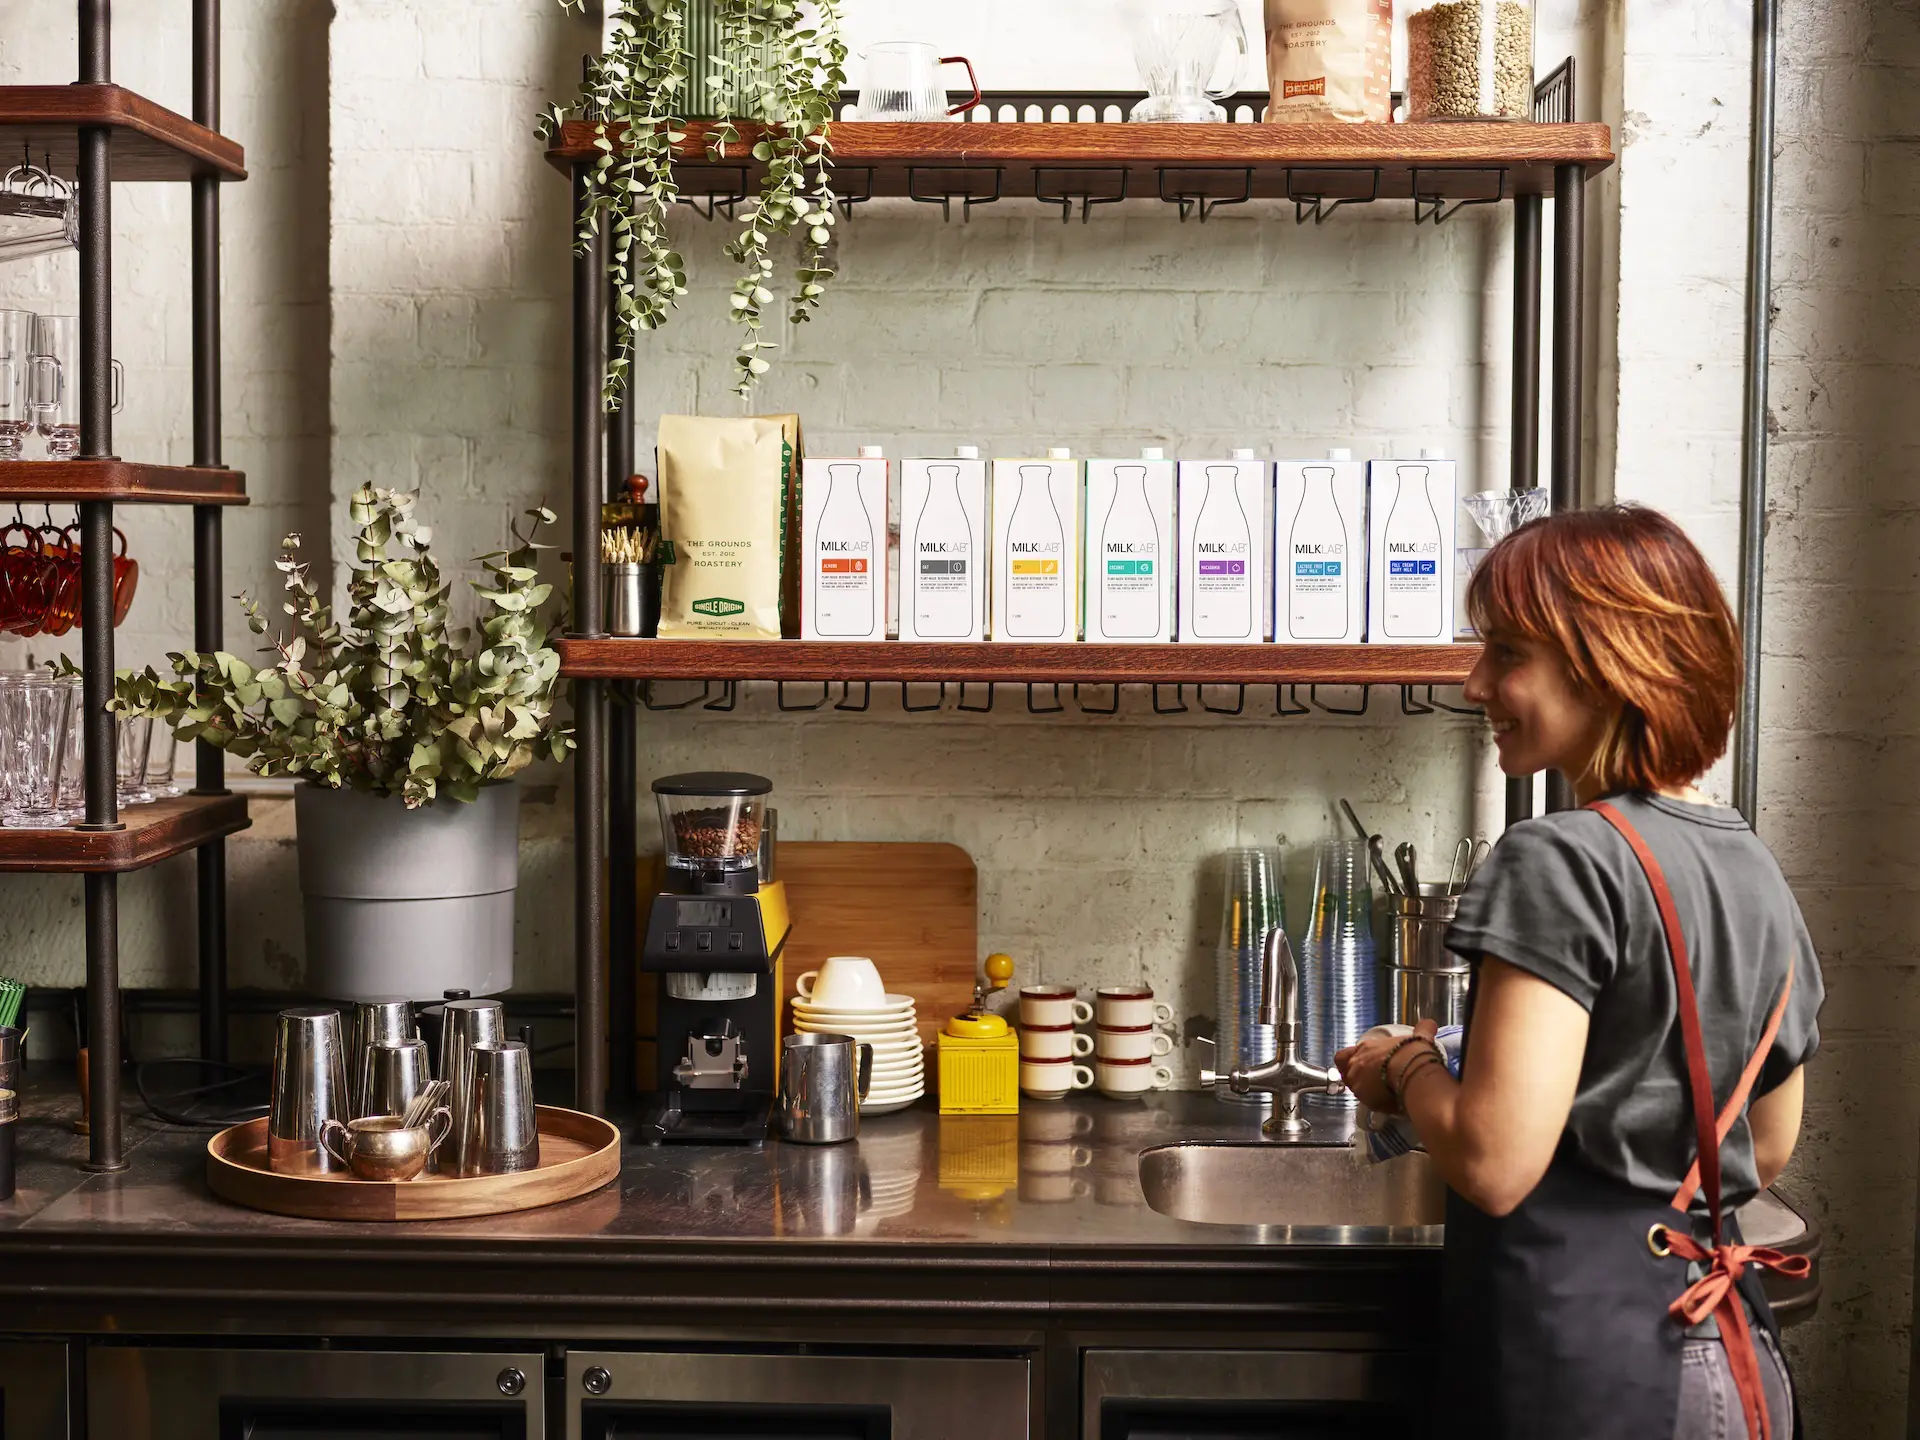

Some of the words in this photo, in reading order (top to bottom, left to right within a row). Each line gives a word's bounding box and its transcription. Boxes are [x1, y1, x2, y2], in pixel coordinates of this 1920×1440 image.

[1296, 20, 1336, 28] GROUNDS
[1284, 40, 1327, 49] ROASTERY
[1285, 82, 1324, 94] DECAF
[821, 541, 868, 551] MILKLAB
[920, 542, 967, 552] MILKLAB
[1012, 542, 1059, 552] MILKLAB
[1107, 543, 1154, 553] MILKLAB
[1198, 543, 1246, 553] MILKLAB
[1295, 544, 1342, 554] MILKLAB
[1389, 542, 1436, 553] MILKLAB
[694, 601, 718, 613] SINGLE
[719, 601, 742, 613] ORIGIN
